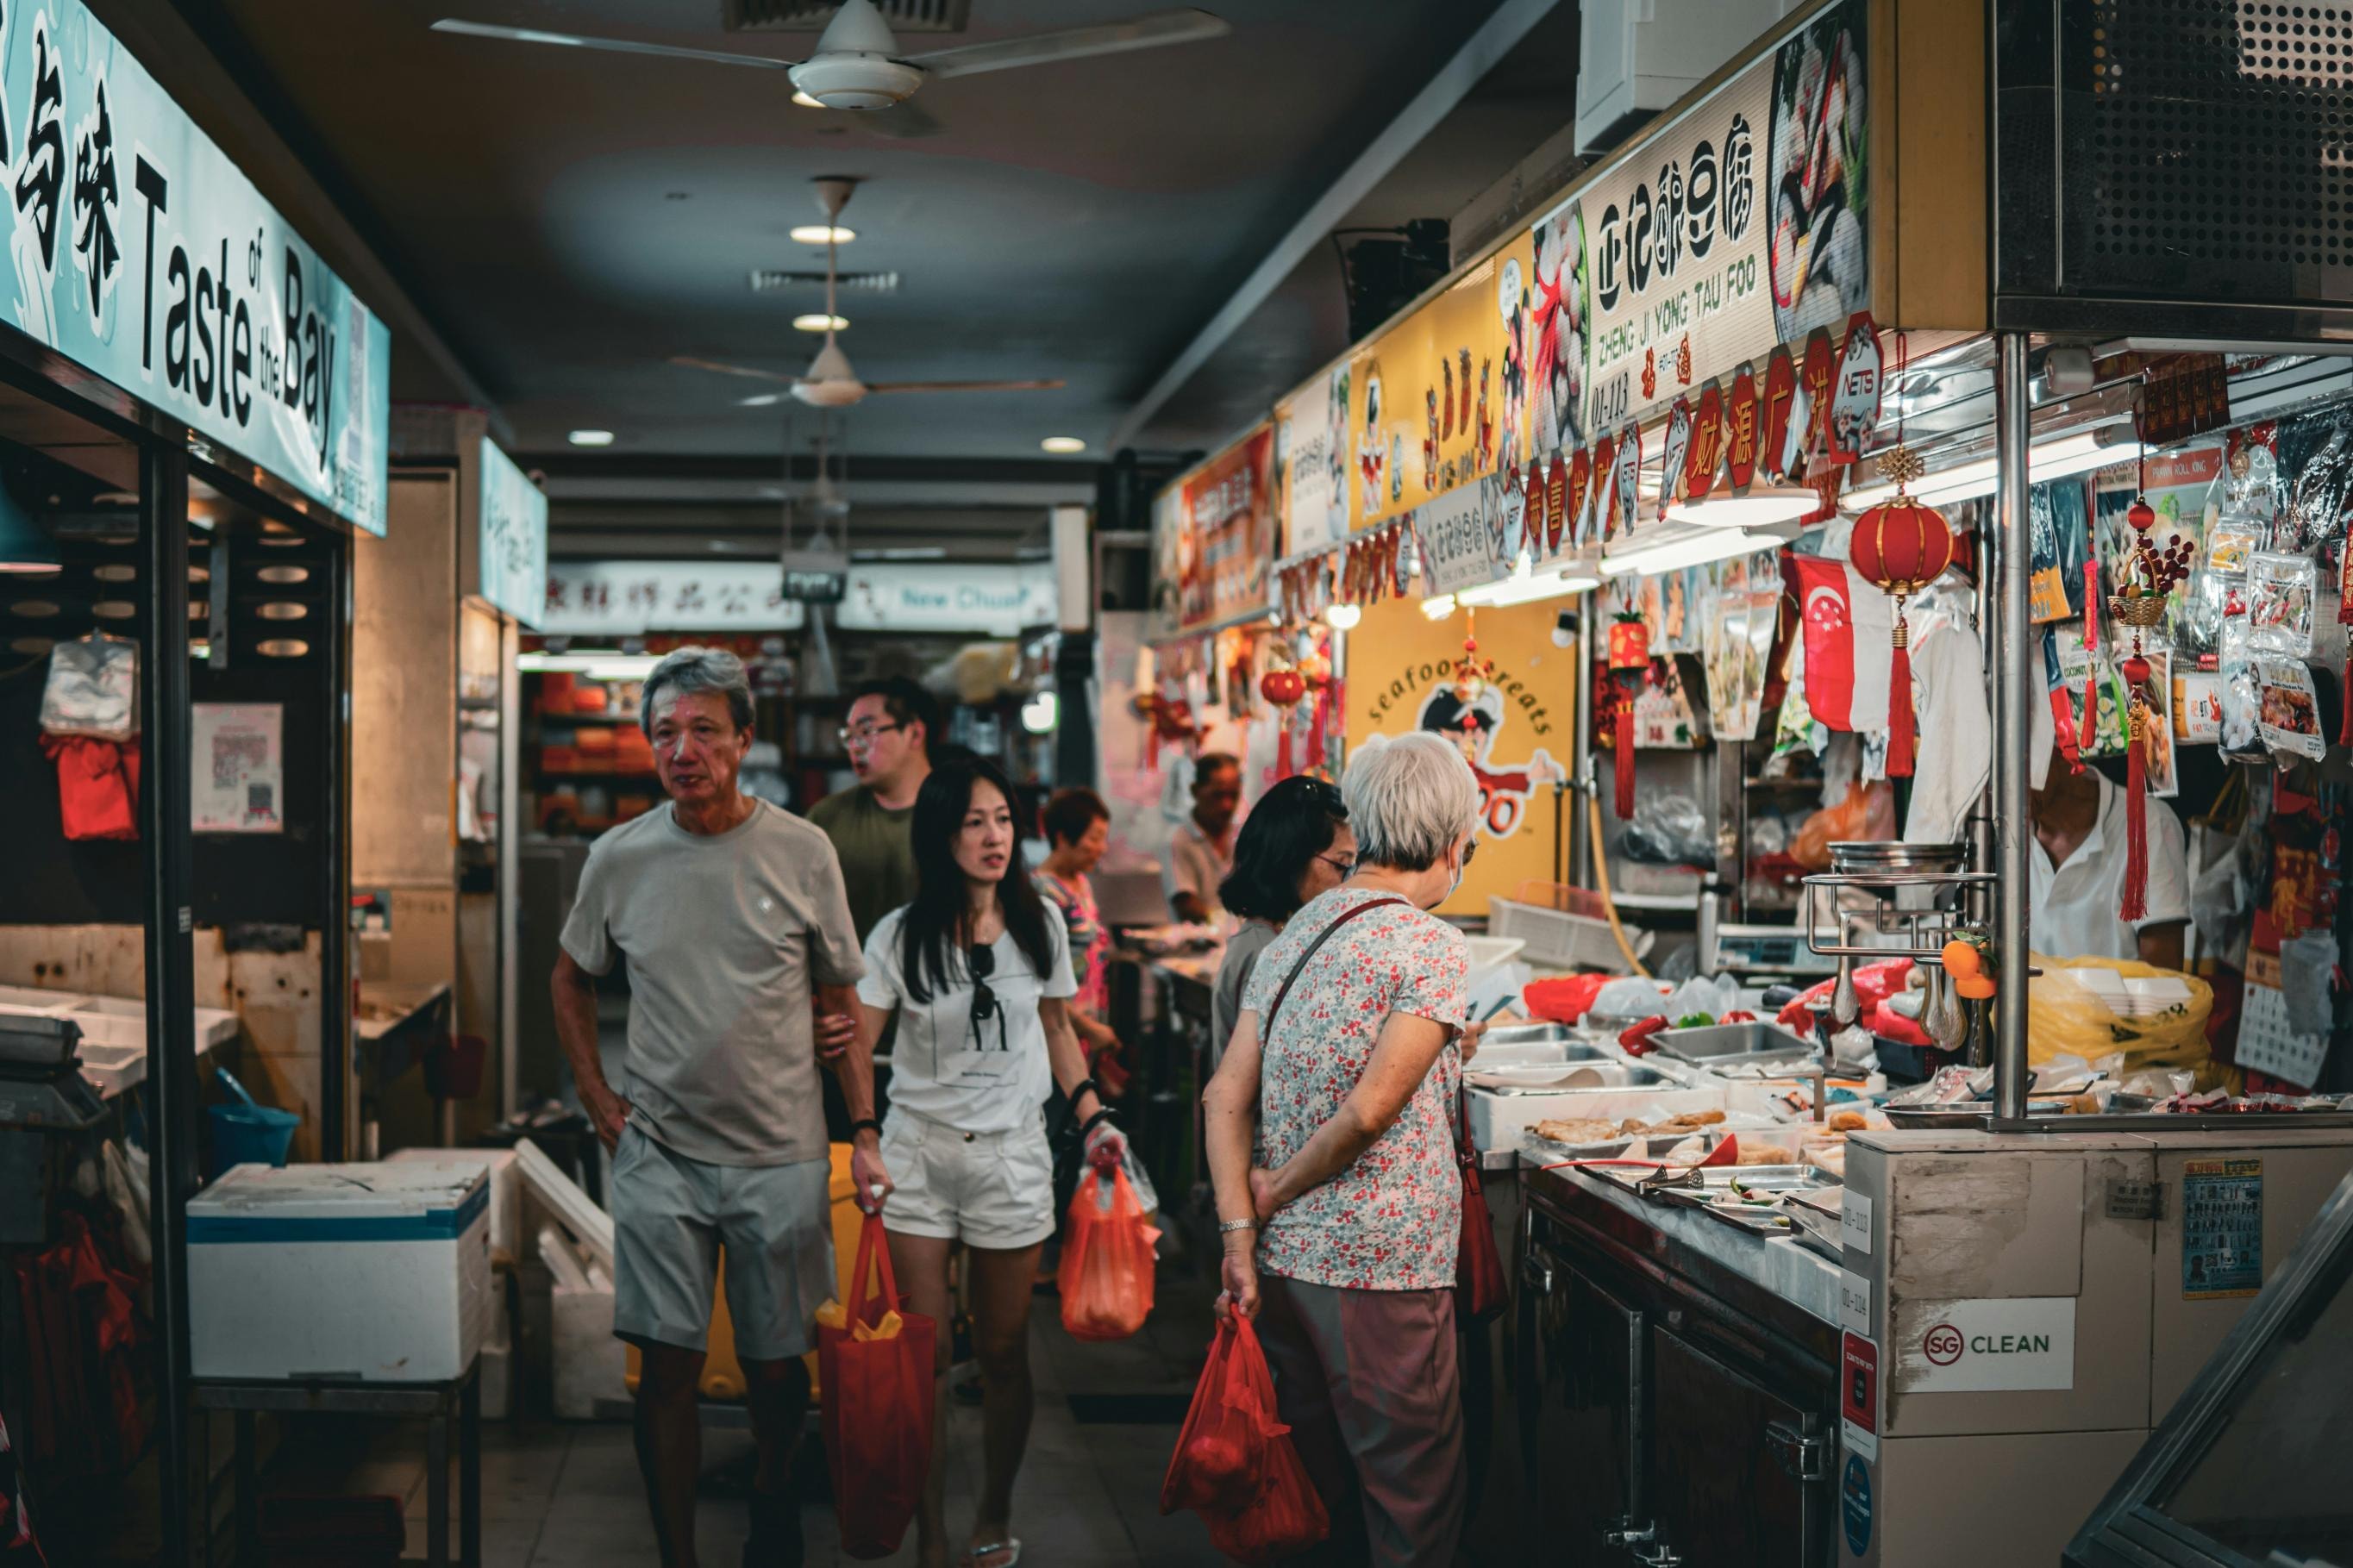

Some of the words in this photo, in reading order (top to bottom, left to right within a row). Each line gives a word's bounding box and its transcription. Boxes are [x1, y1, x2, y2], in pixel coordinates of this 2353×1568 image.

[135, 153, 252, 428] Taste
[248, 227, 263, 288] of
[260, 327, 280, 401] the
[285, 246, 335, 472] Bay
[1599, 319, 1635, 368] ZHENG
[1640, 317, 1650, 350] JI
[1654, 293, 1689, 336] YONG
[1694, 277, 1721, 320] TAU
[1727, 254, 1756, 297] FOO
[1842, 368, 1874, 397] NETS
[1592, 372, 1629, 428] 01-113
[2192, 459, 2206, 473] KING
[1843, 1206, 1869, 1234] 01-113
[1842, 1287, 1868, 1316] 01-114
[1929, 1334, 1960, 1355] SG
[1970, 1334, 2050, 1354] CLEAN
